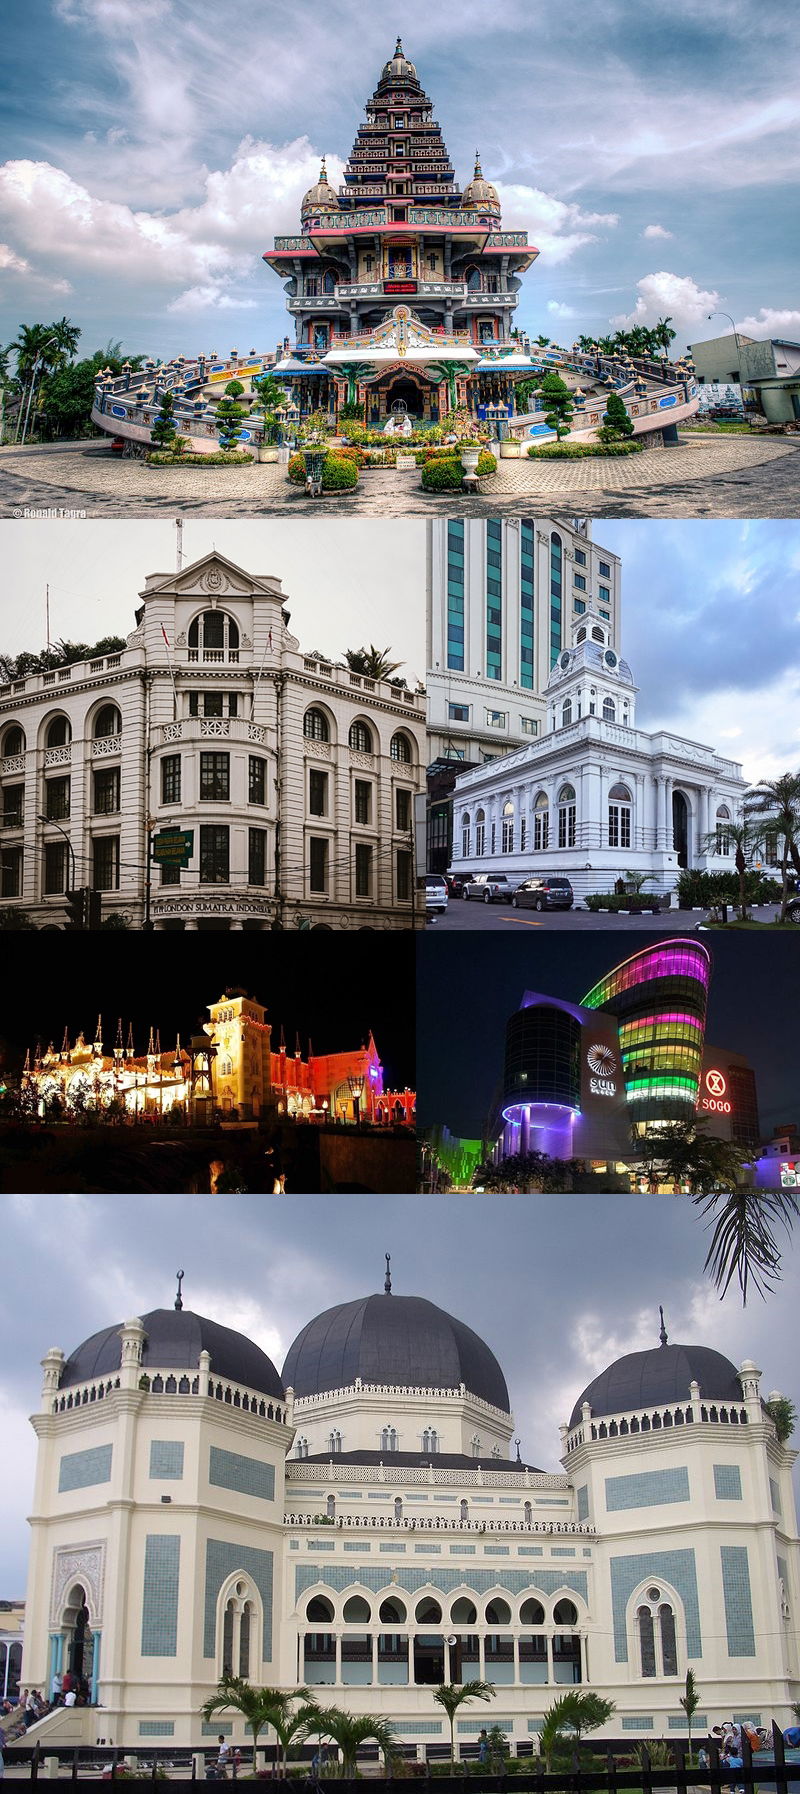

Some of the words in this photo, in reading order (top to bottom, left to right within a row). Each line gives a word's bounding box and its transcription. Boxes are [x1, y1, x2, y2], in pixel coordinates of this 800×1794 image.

[164, 904, 194, 913] LONDON
[195, 903, 234, 912] SUMATRA
[590, 1077, 617, 1092] sun
[702, 1098, 731, 1113] SOGO
